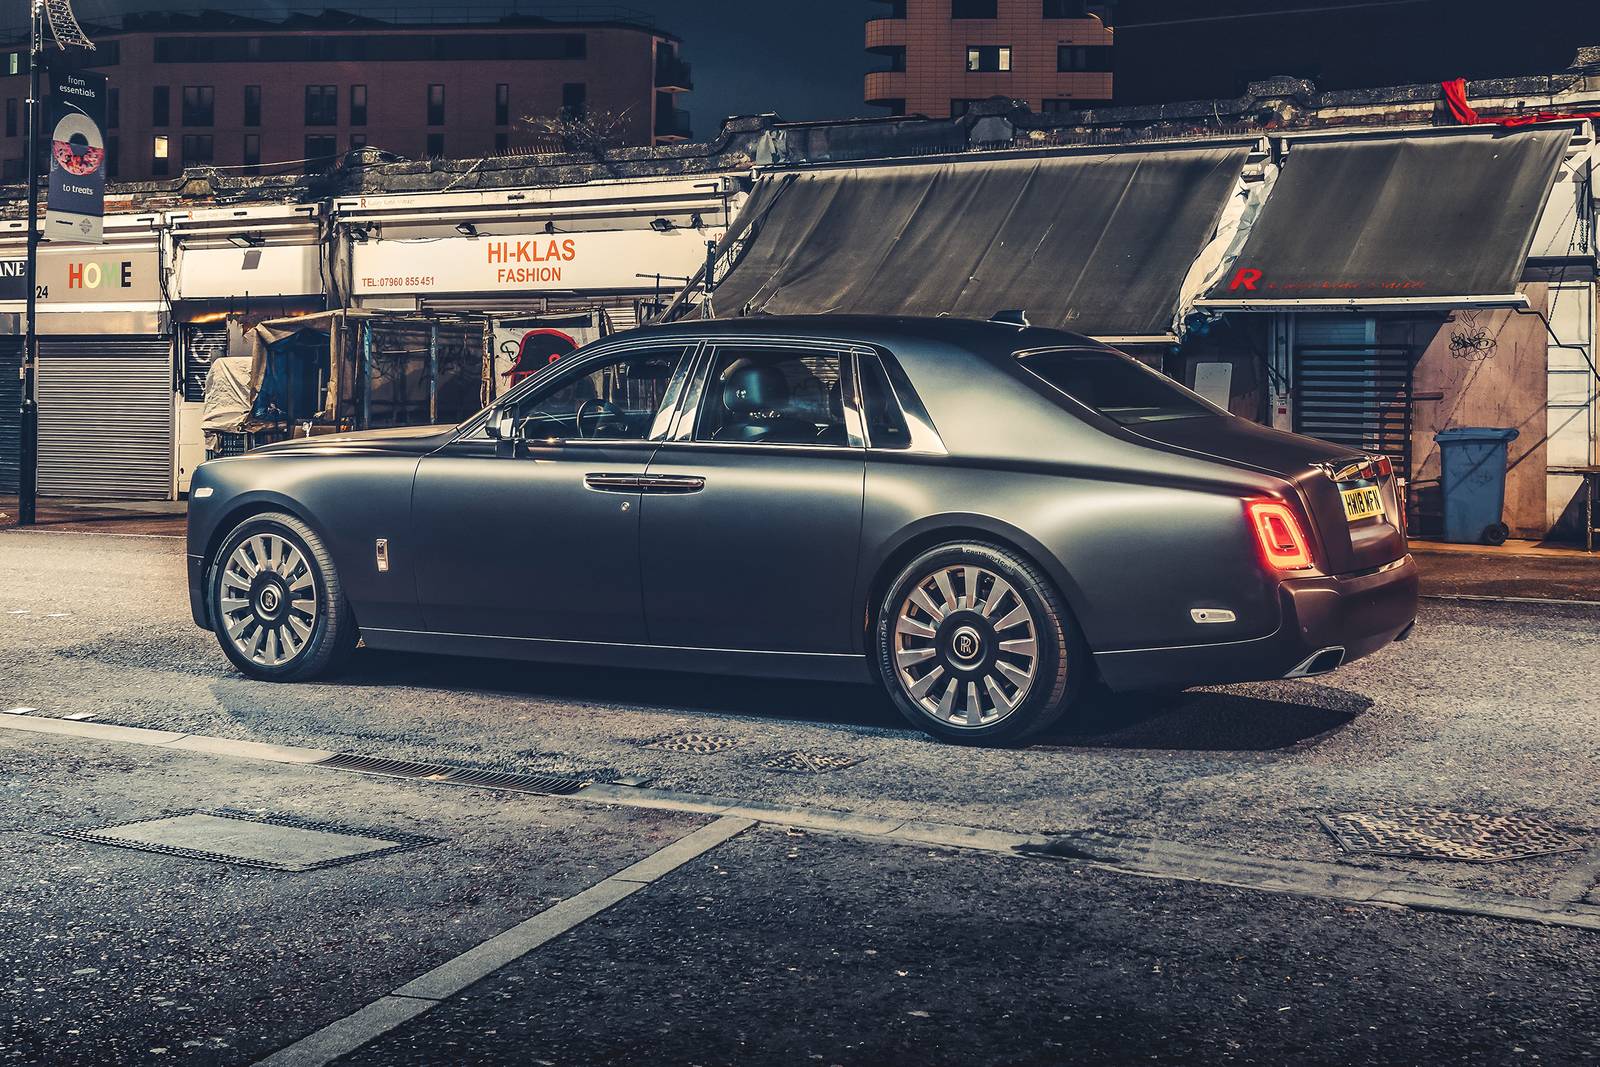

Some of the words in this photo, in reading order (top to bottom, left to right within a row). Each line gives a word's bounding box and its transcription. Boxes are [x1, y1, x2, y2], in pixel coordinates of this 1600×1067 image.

[68, 75, 86, 86] from
[59, 85, 96, 98] essentials
[63, 184, 71, 192] to
[72, 185, 93, 196] treats
[487, 239, 576, 263] HI-KLAS
[68, 261, 132, 289] HOME
[361, 277, 403, 287] TEL:07960
[497, 267, 561, 283] FASHION
[1229, 267, 1263, 290] R
[36, 285, 49, 299] 24
